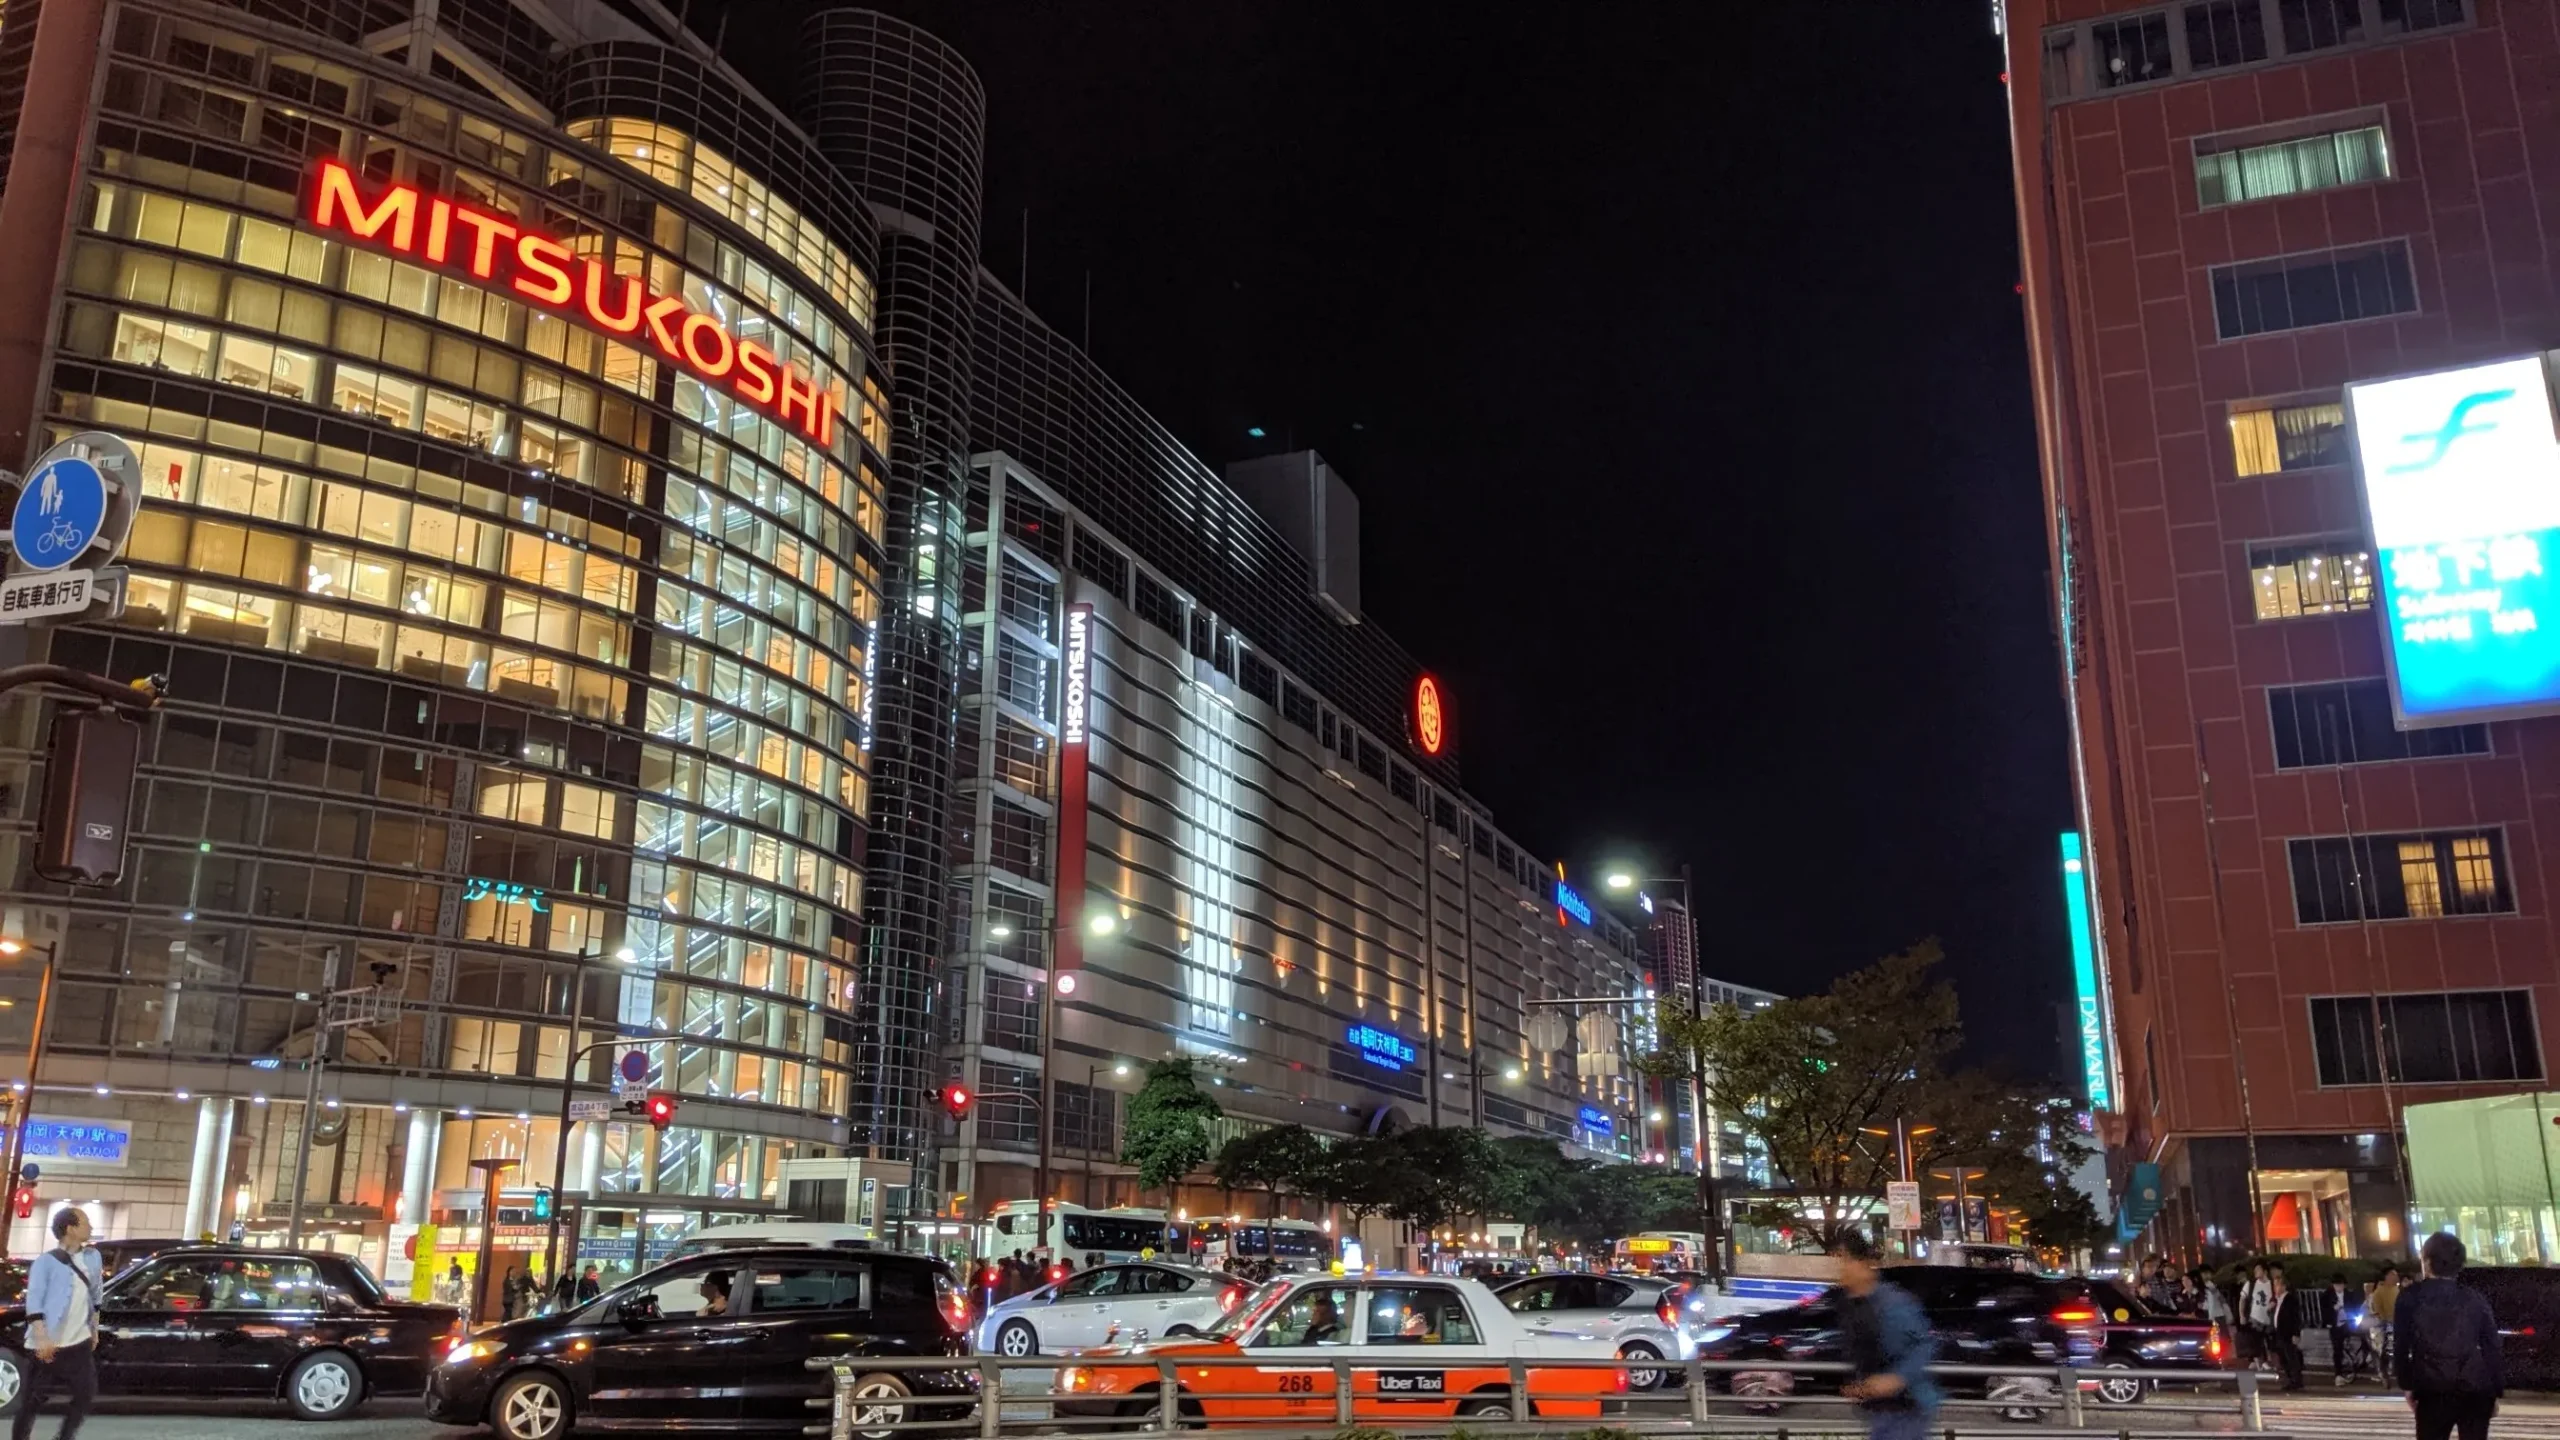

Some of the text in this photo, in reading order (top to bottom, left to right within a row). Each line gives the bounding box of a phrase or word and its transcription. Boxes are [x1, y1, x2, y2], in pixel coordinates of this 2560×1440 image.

[316, 163, 833, 446] MITSUKOSHI
[3, 579, 86, 612] 自転車通行可
[1066, 611, 1087, 744] MITSUKOSHI
[1558, 881, 1591, 925] Nishitetsu
[1279, 1375, 1313, 1392] 268
[1380, 1376, 1442, 1390] Uber Taxi
